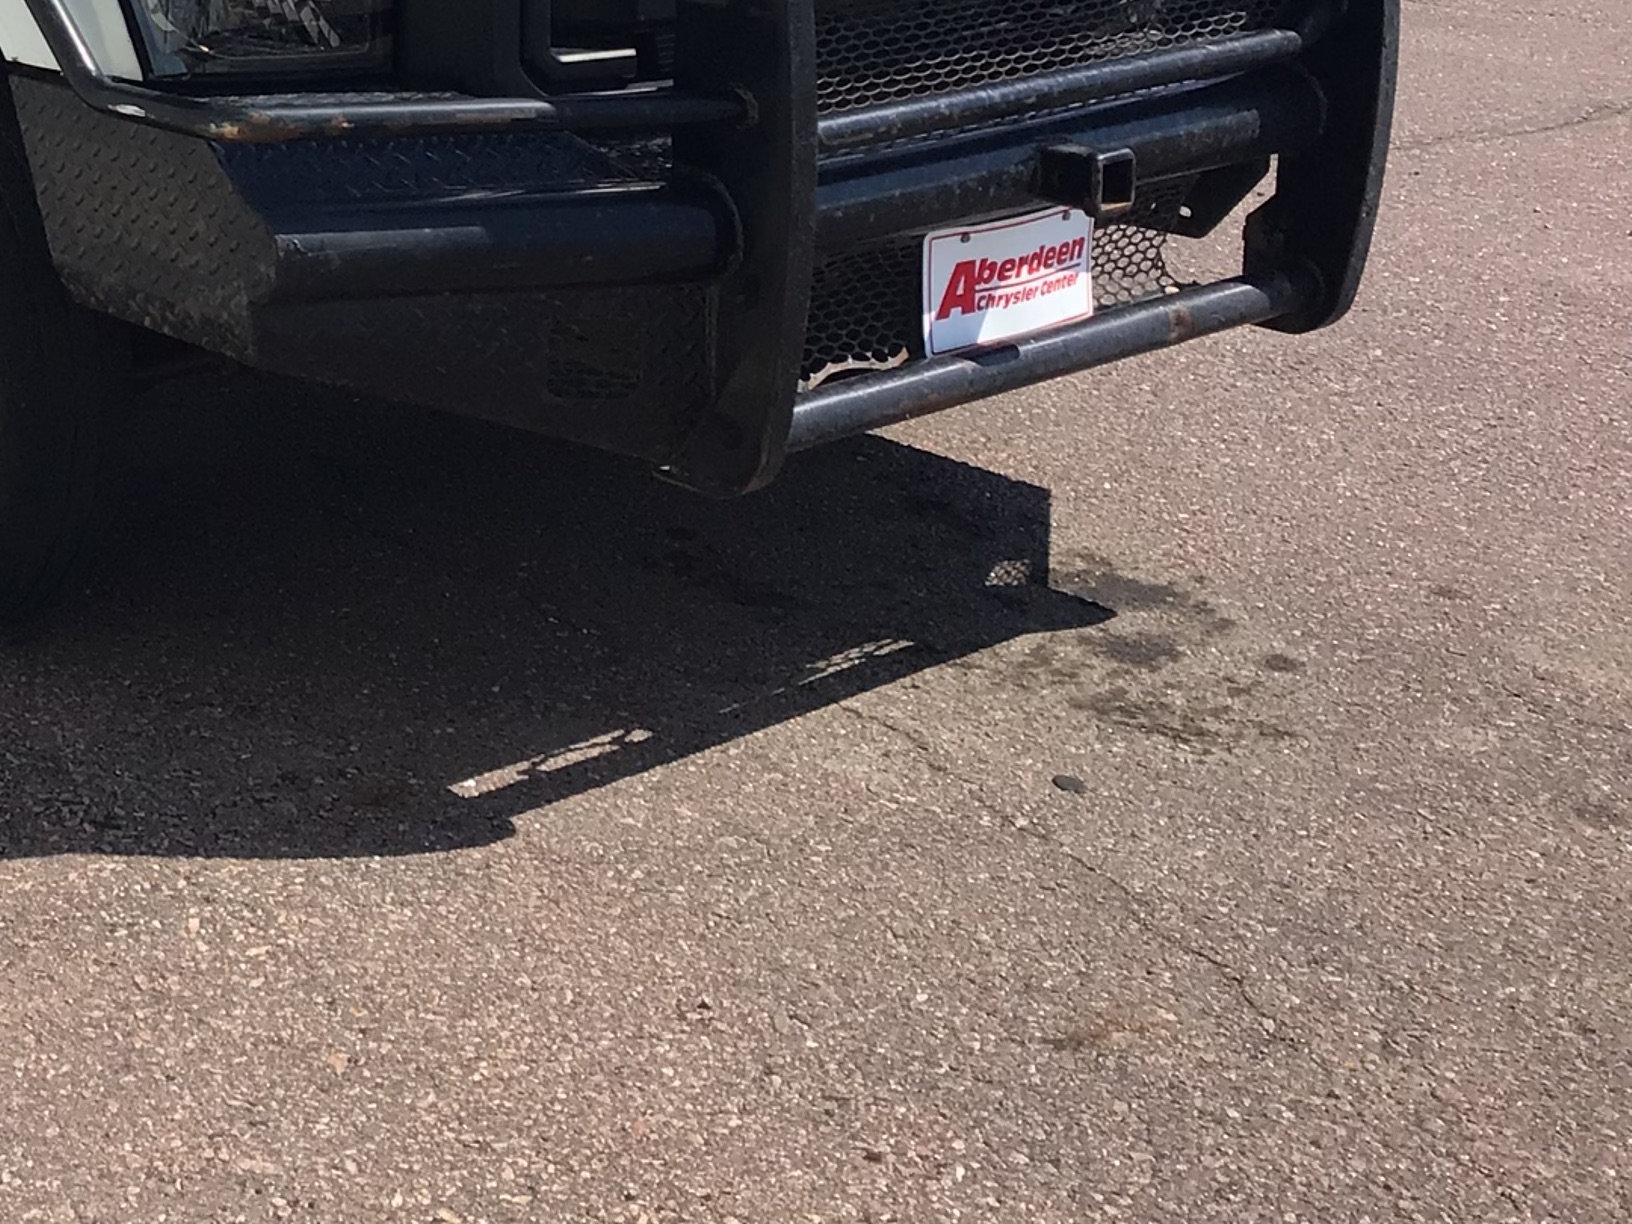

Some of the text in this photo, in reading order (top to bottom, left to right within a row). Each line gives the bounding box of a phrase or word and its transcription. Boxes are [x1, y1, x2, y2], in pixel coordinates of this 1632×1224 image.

[935, 236, 1086, 321] Aberdeen
[976, 272, 1079, 312] Chrysler Center
